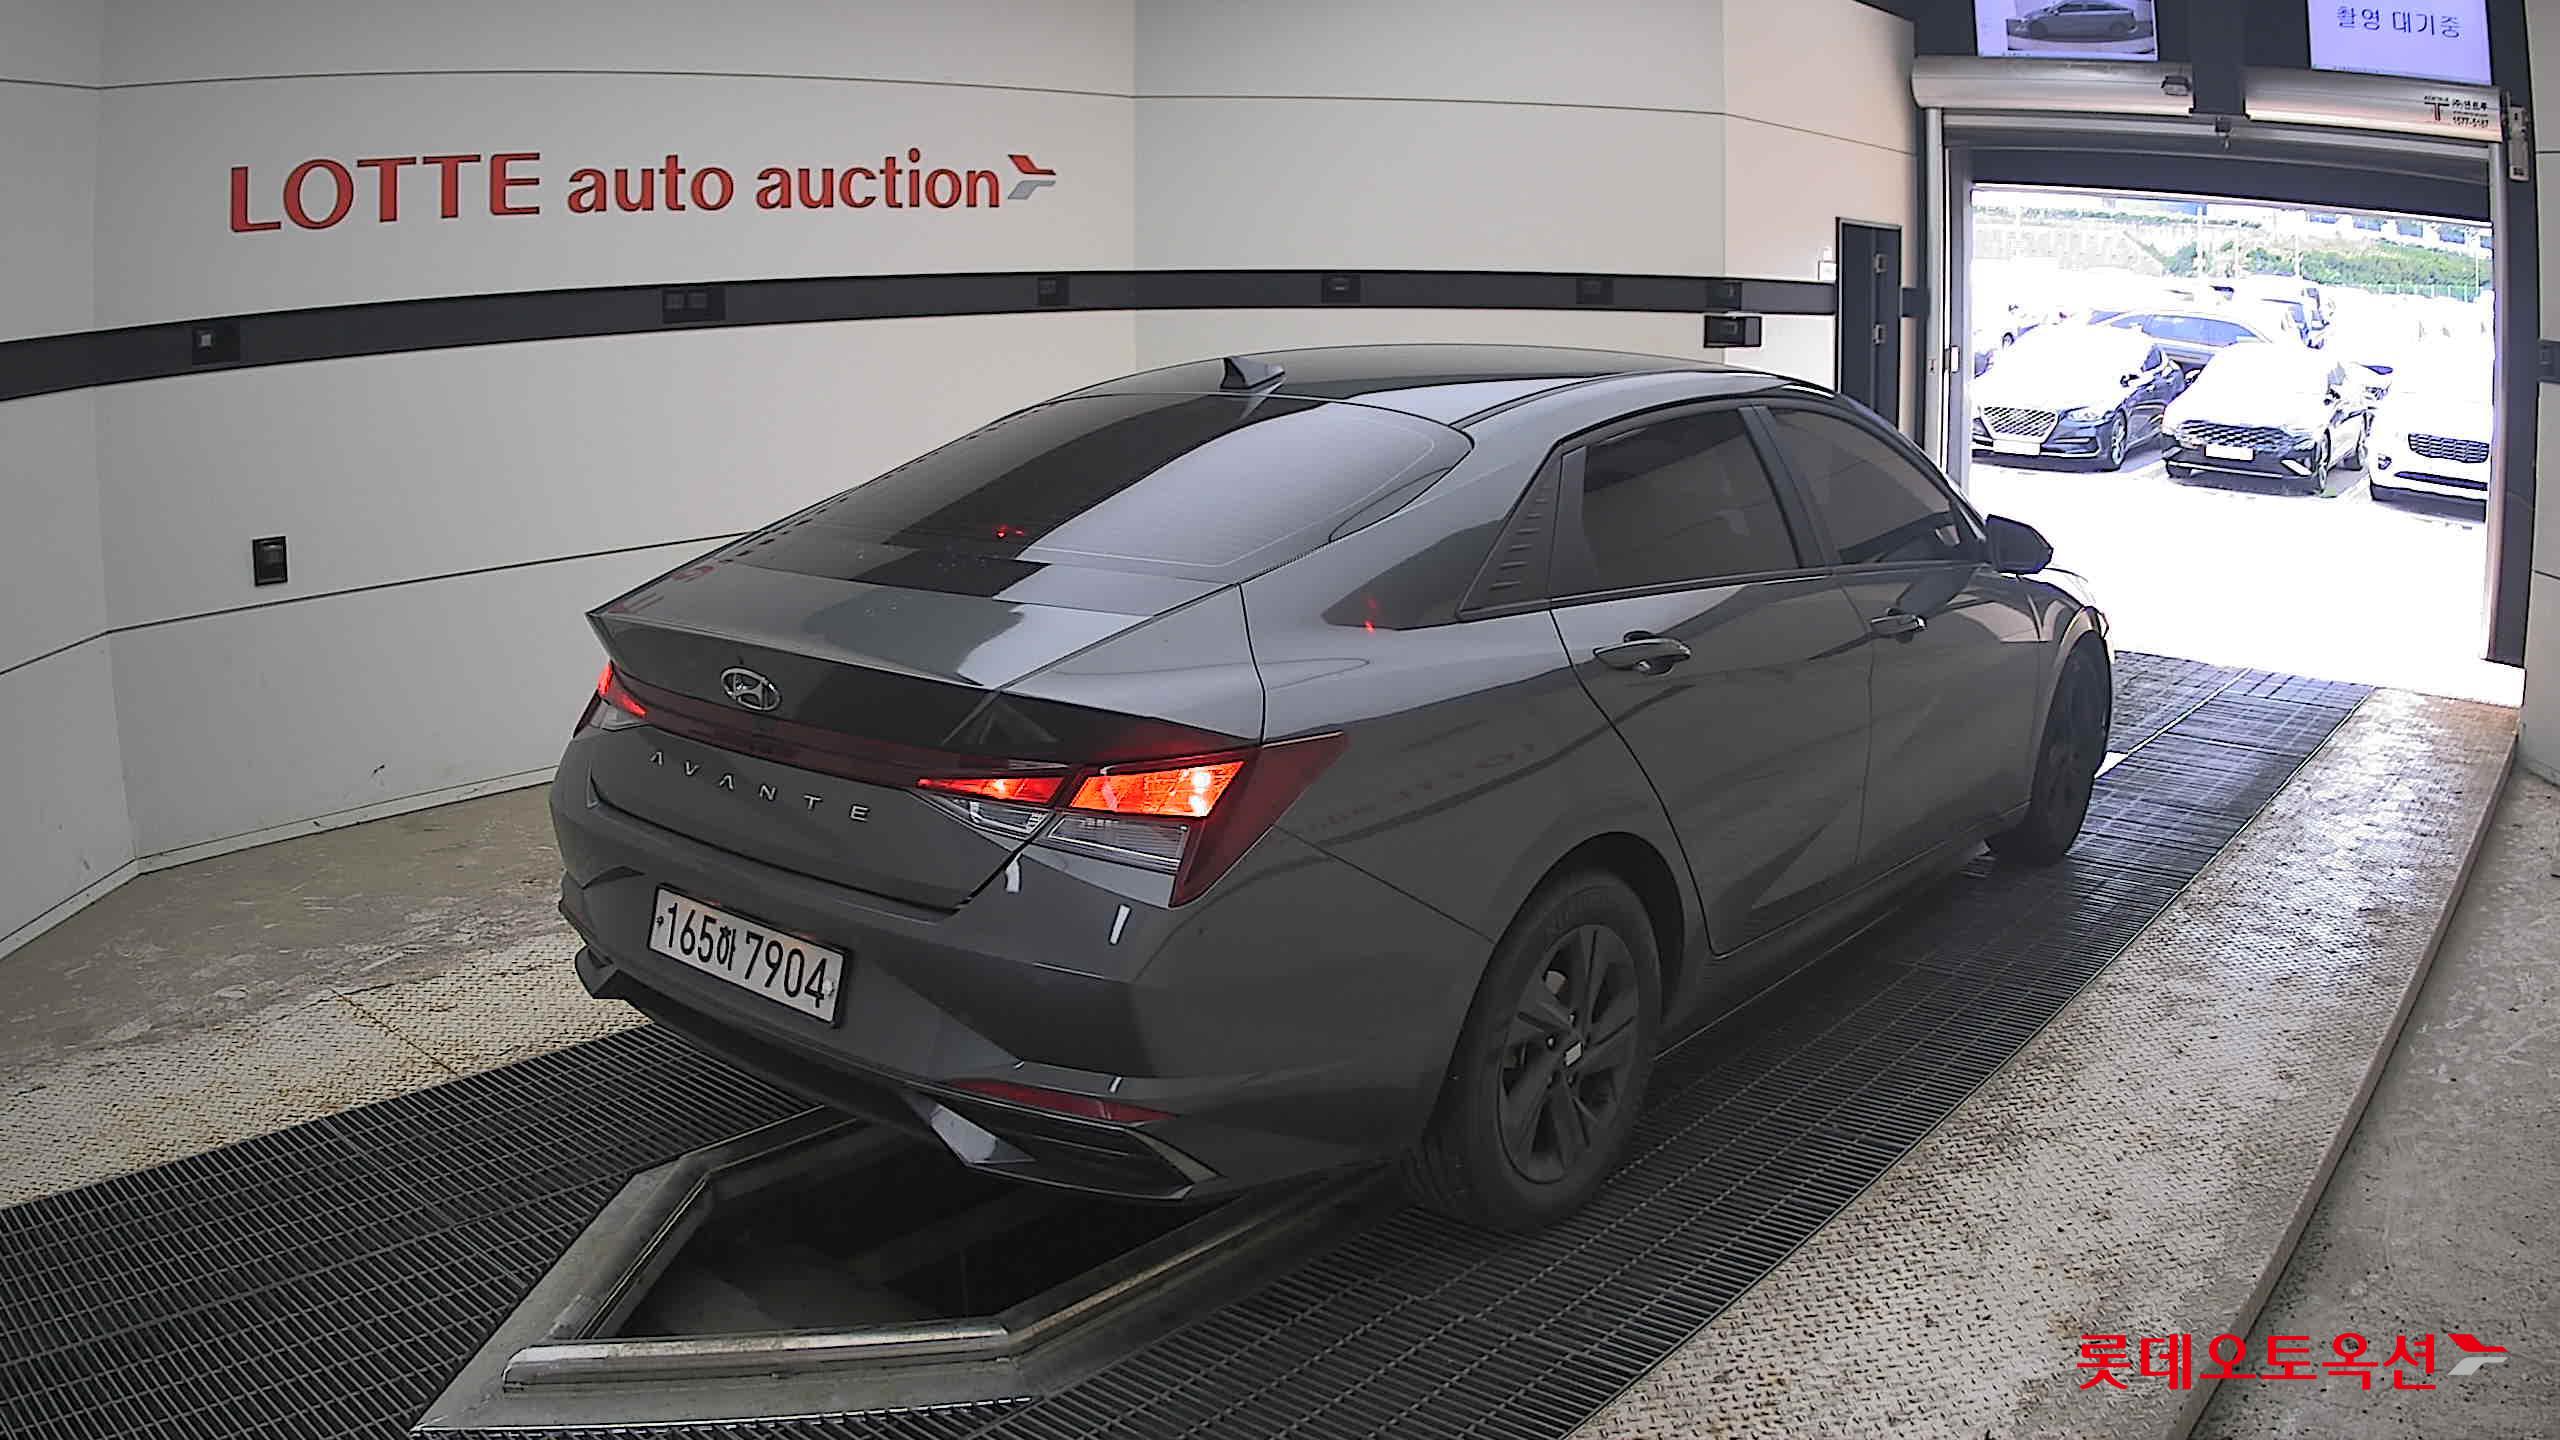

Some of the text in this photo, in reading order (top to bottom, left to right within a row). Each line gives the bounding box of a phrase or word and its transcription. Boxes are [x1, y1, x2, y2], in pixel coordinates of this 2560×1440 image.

[2337, 6, 2463, 39] 촬영 대기중
[230, 148, 1001, 234] LOTTE auto auction
[650, 750, 869, 822] AVANTE
